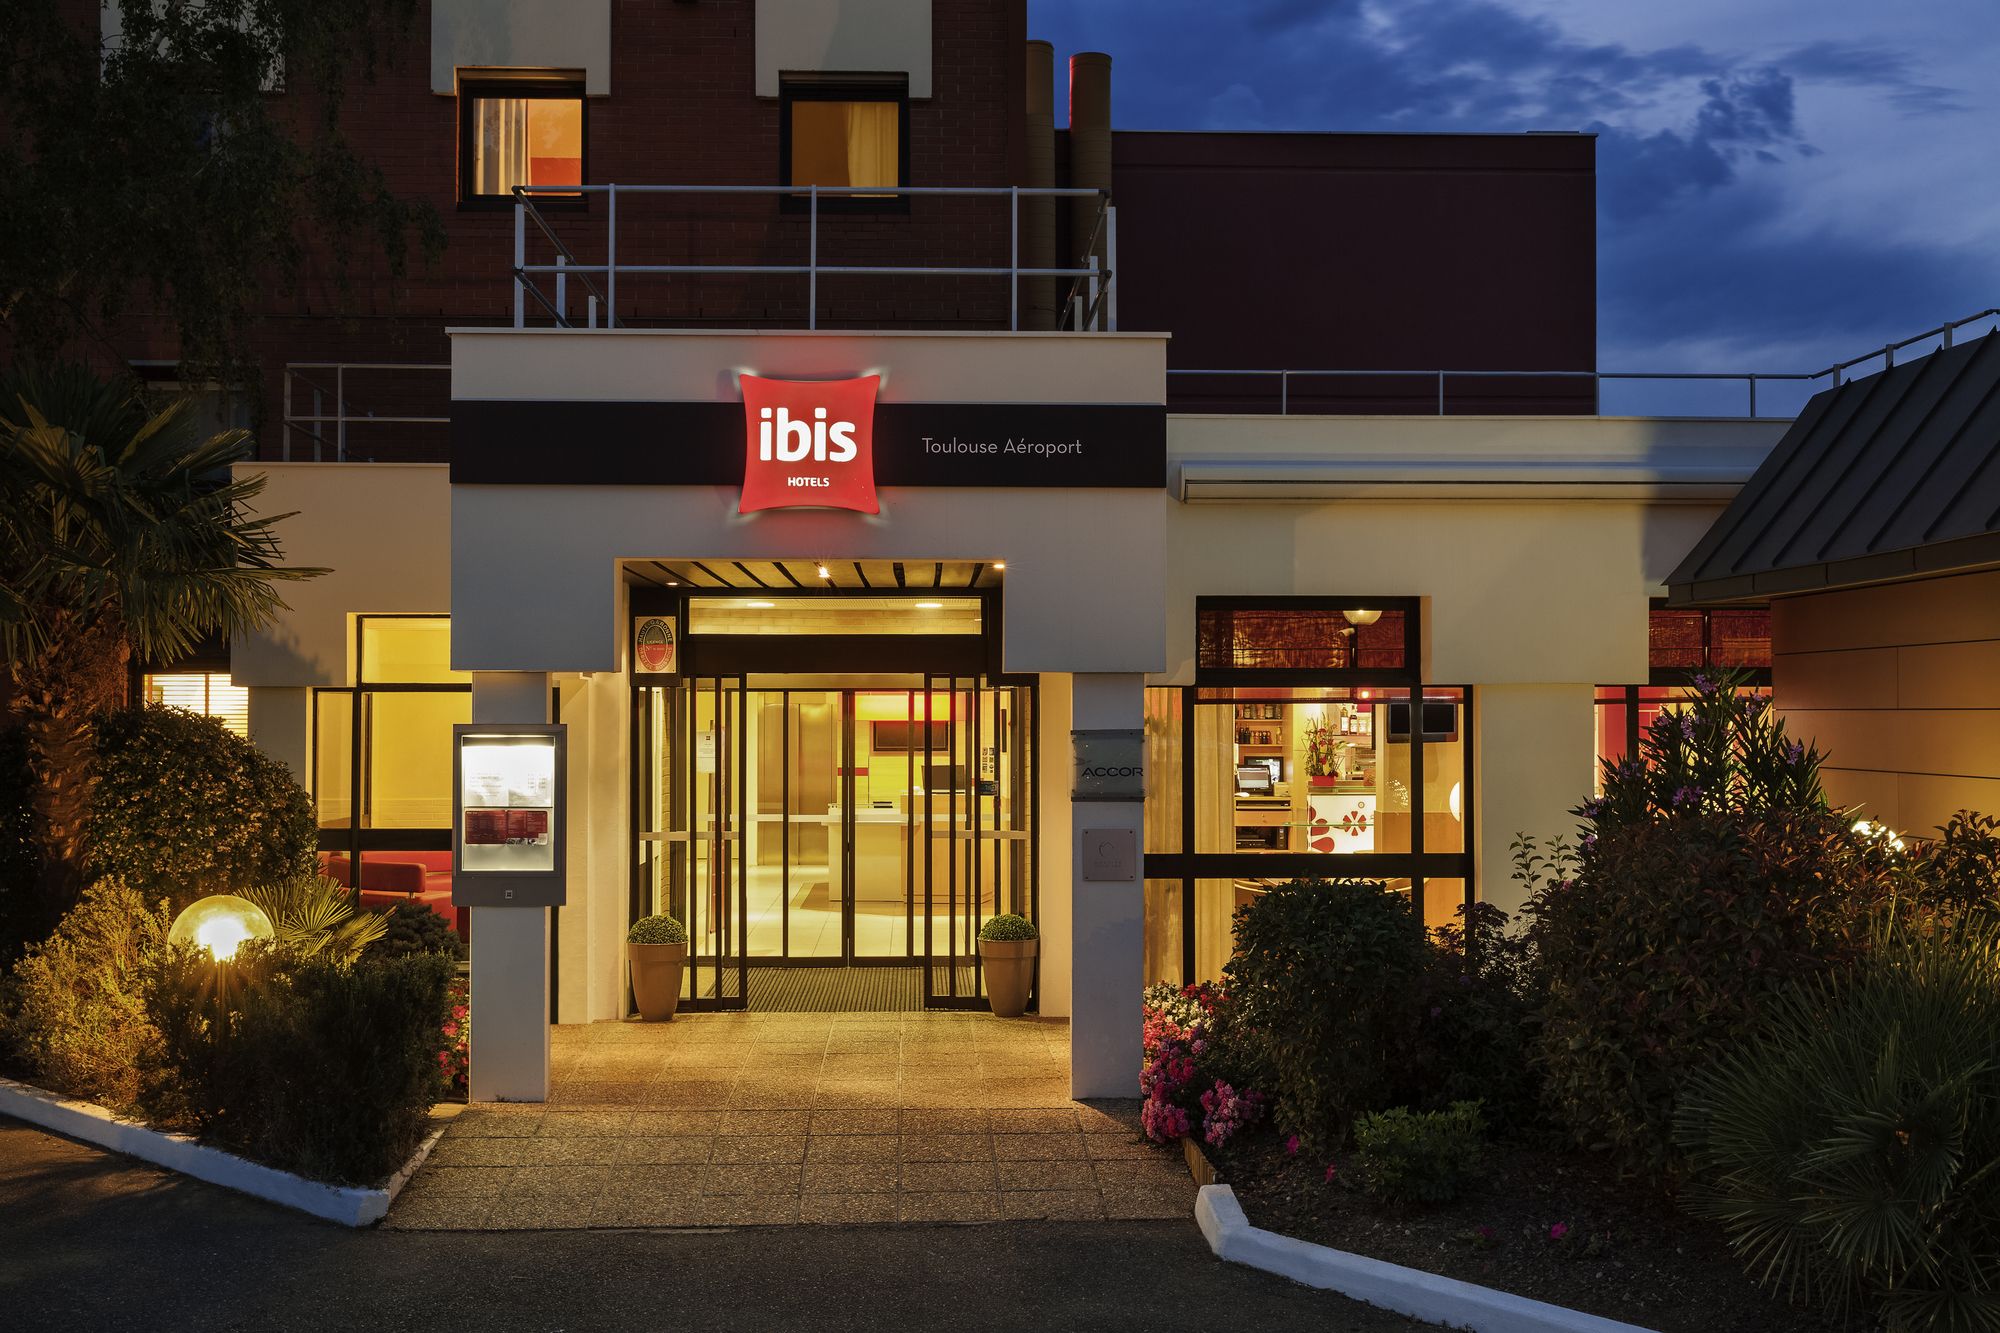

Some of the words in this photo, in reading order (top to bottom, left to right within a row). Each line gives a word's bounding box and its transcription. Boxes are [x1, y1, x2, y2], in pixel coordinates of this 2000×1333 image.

[760, 407, 858, 462] ibis
[921, 437, 998, 454] Toulouse
[1003, 437, 1082, 458] Aéroport
[787, 476, 830, 488] HOTELS
[1081, 767, 1144, 777] ACCOR
